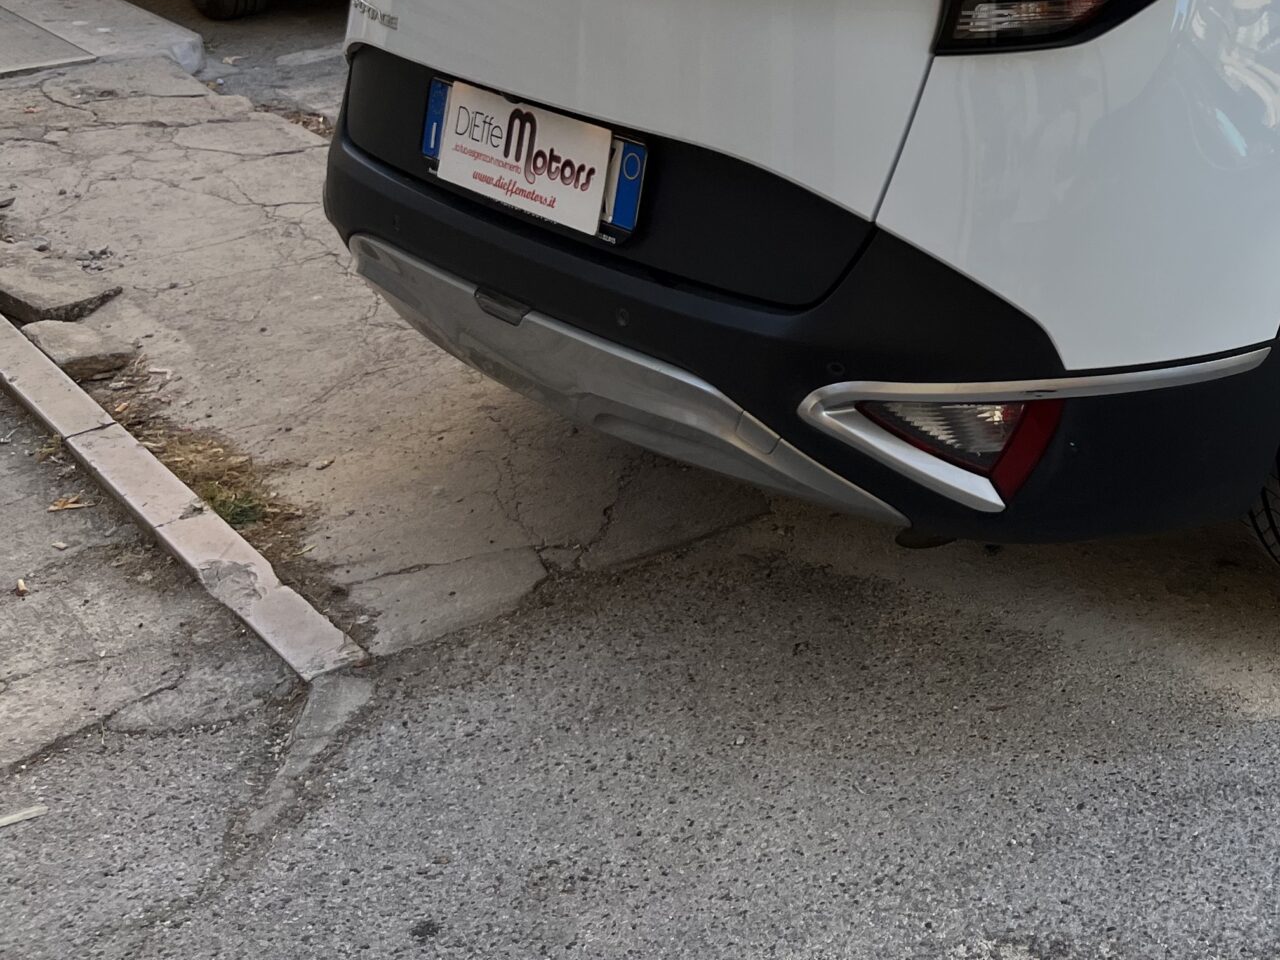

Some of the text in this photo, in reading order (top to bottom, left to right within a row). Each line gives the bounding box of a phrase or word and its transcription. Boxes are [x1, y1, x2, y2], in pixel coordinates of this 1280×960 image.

[455, 105, 596, 192] DiEffe Motors
[472, 170, 557, 209] www.dieffemotors.it
